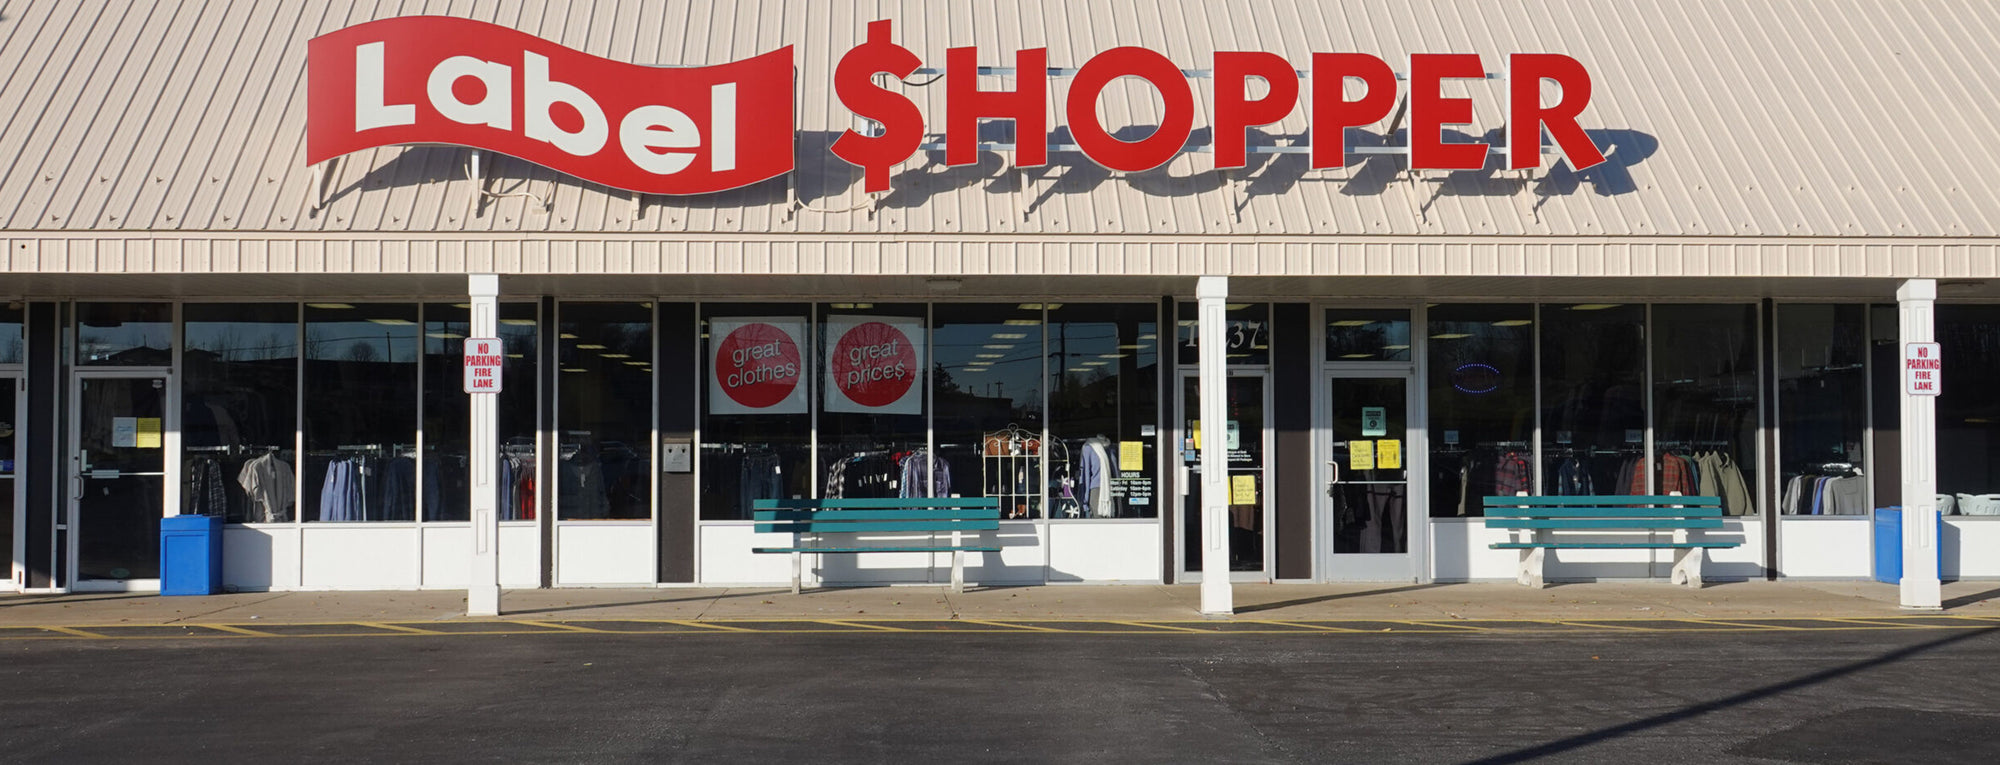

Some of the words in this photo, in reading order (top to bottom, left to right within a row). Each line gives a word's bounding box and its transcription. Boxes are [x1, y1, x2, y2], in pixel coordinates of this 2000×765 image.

[355, 41, 737, 175] Label
[828, 18, 1607, 194] $HOPPER
[477, 343, 489, 354] NO
[732, 338, 782, 368] great
[849, 338, 899, 367] great
[1917, 347, 1928, 358] NO
[465, 355, 501, 366] PARKING
[1907, 359, 1940, 370] PARKING
[474, 368, 492, 377] FIRE
[727, 361, 796, 388] clothes
[1915, 371, 1931, 379] FIRE
[473, 379, 493, 388] LANE
[1914, 381, 1933, 390] LANE
